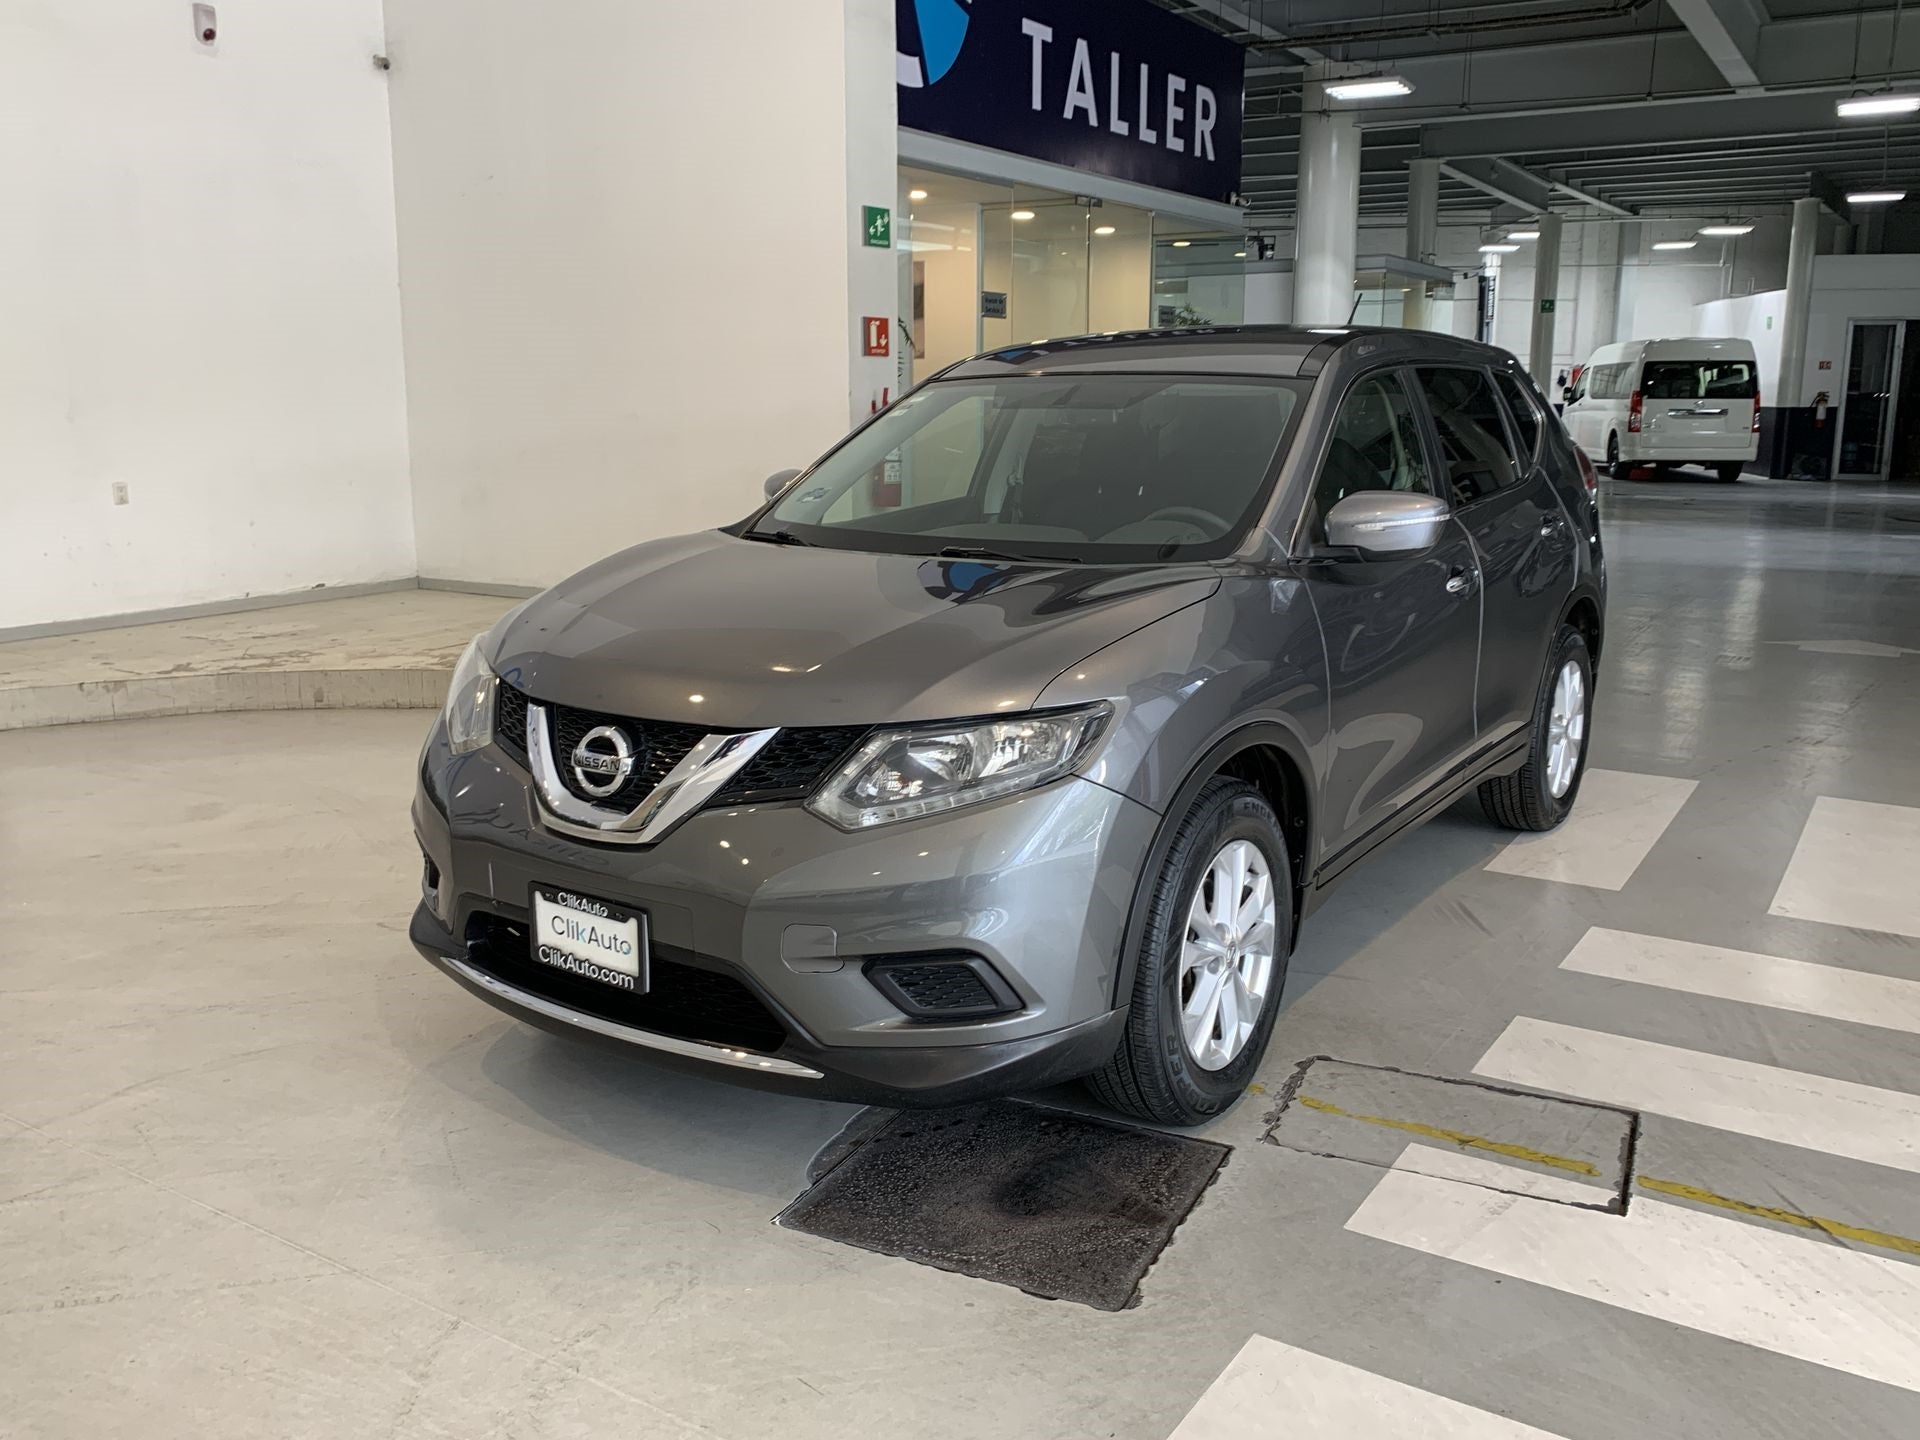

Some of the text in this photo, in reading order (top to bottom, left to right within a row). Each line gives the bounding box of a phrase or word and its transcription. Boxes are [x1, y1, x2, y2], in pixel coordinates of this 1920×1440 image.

[1021, 17, 1217, 161] TALLER
[574, 753, 620, 771] NISSAN
[558, 892, 608, 918] ClikAuto
[551, 915, 632, 956] ClikAuto
[538, 944, 634, 990] ClikAuto.com
